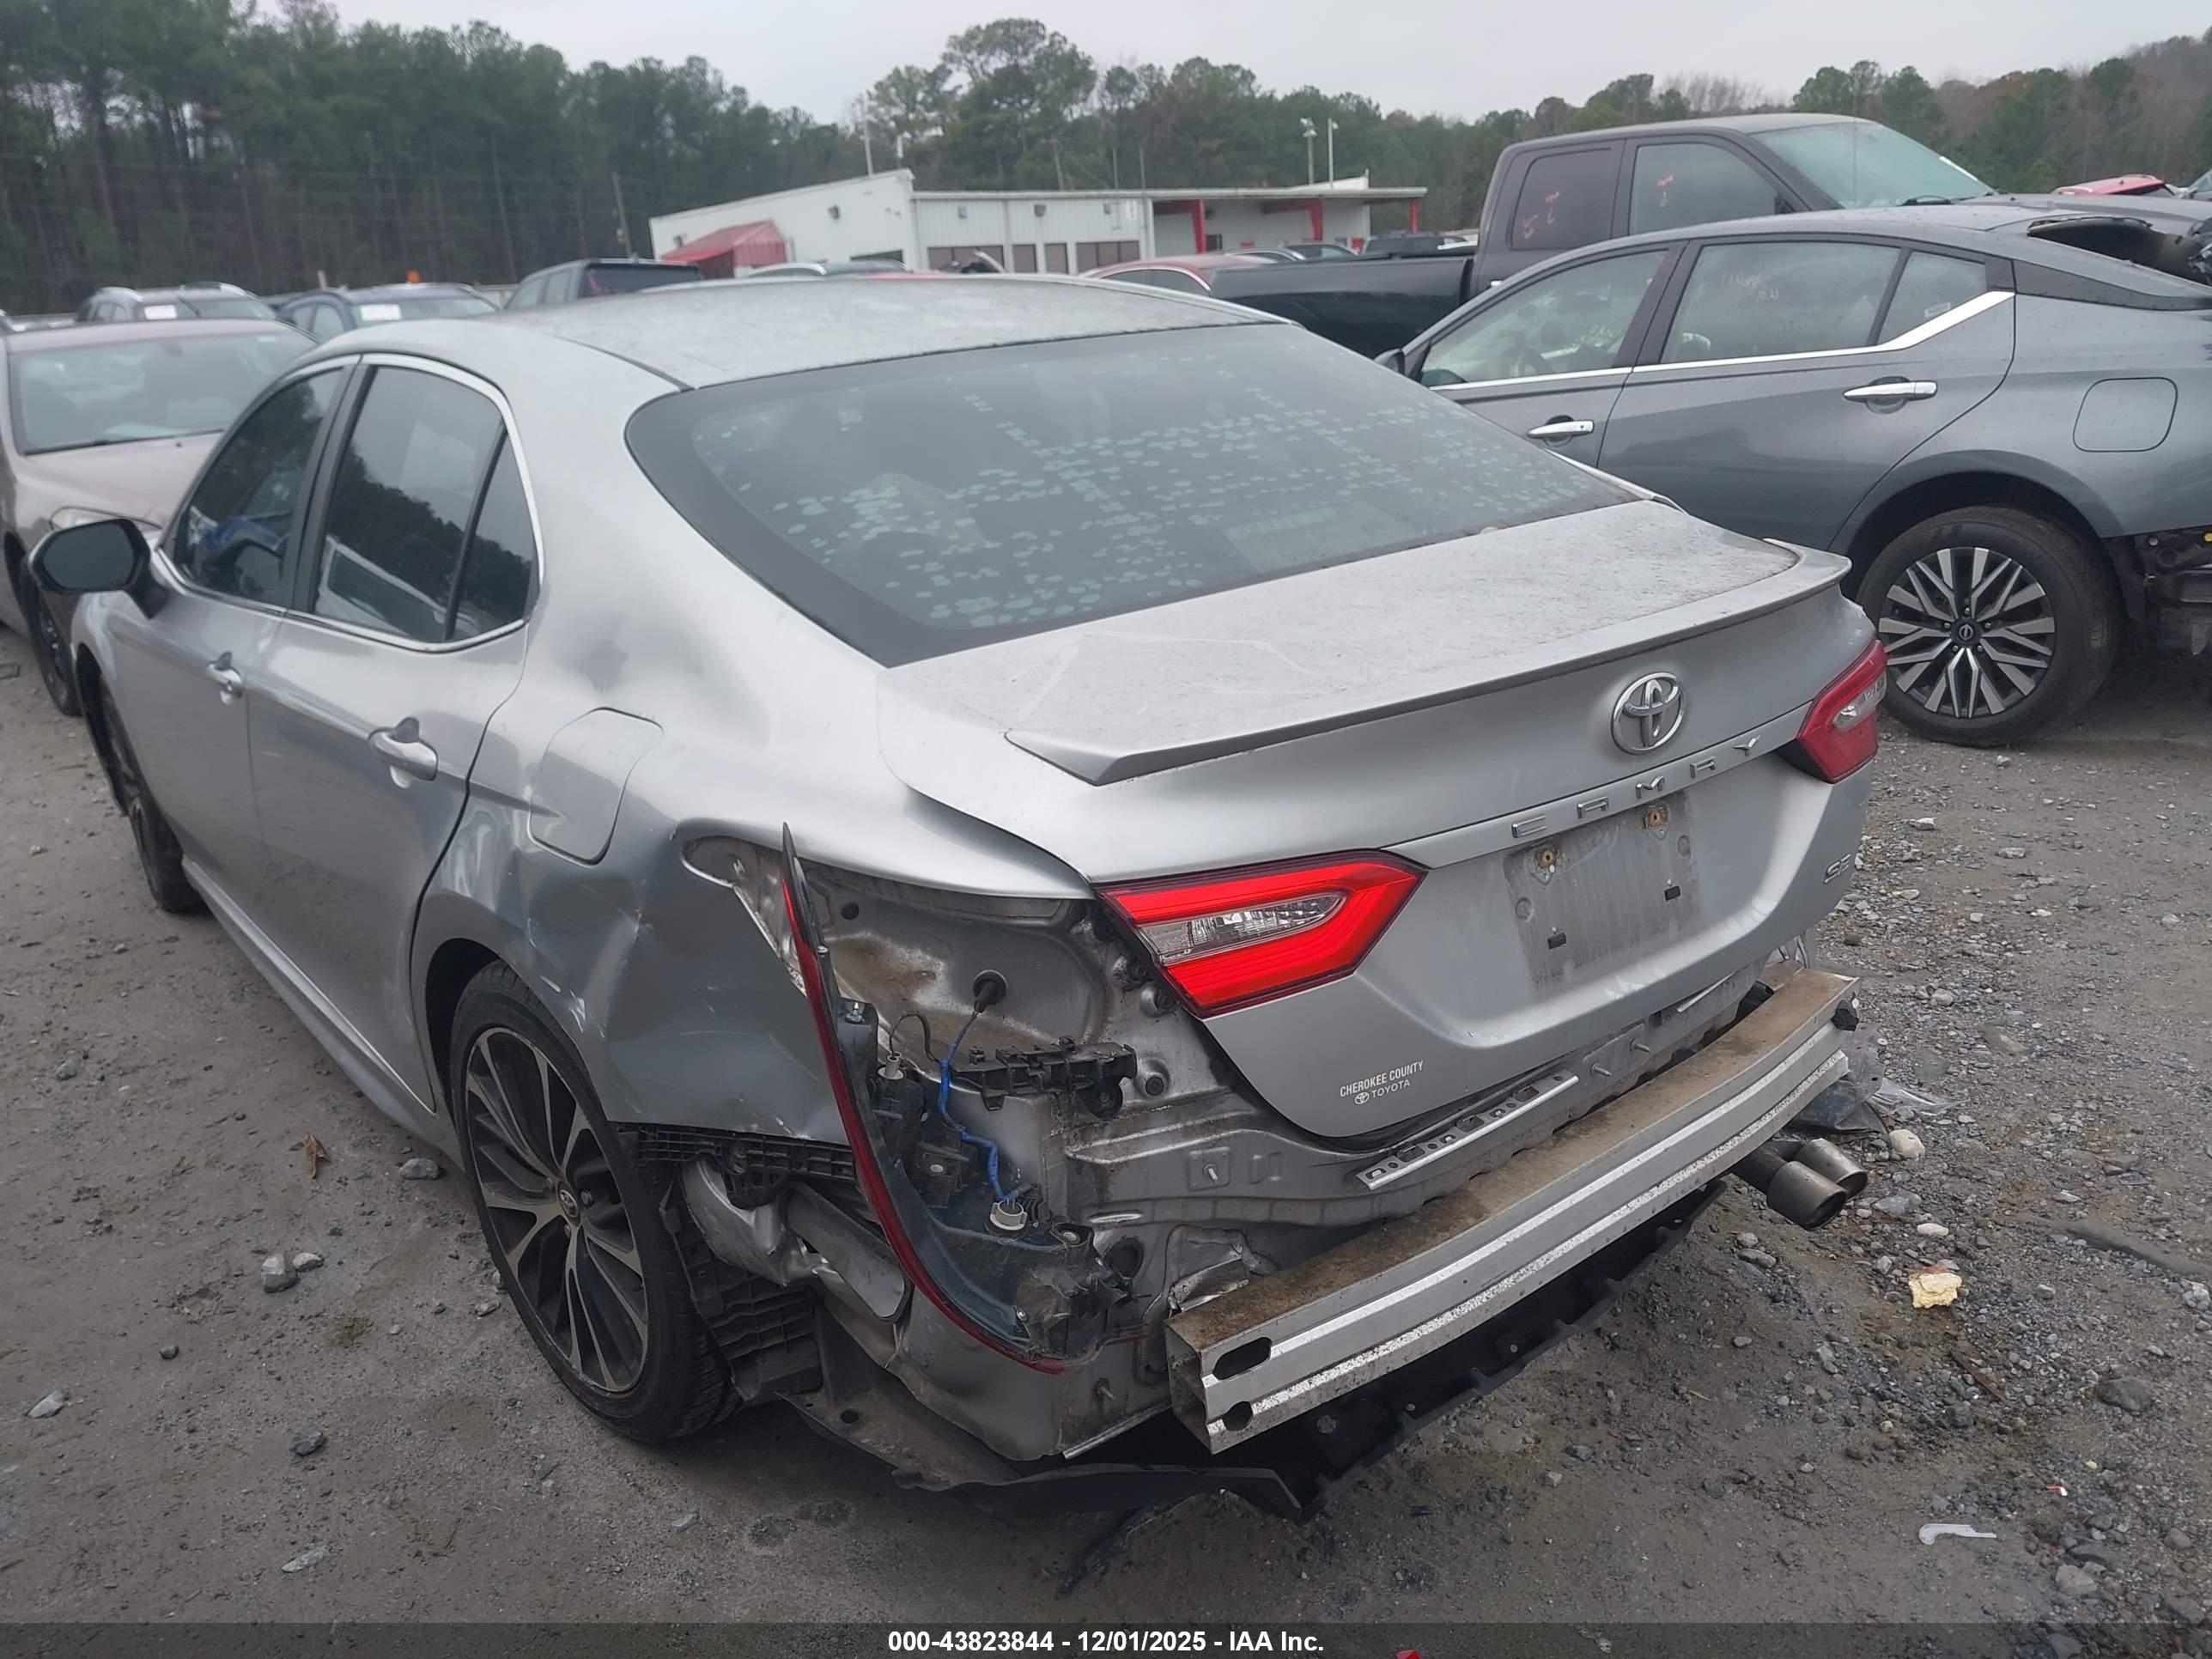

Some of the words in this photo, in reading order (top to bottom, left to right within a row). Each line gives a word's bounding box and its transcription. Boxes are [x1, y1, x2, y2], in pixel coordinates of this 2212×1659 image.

[1510, 734, 1761, 838] CAMRY
[1823, 854, 1851, 884] SE
[1340, 1073, 1388, 1097] CHEROKEE
[1389, 1060, 1424, 1081] COUNTY
[1371, 1079, 1410, 1098] TOYOTA
